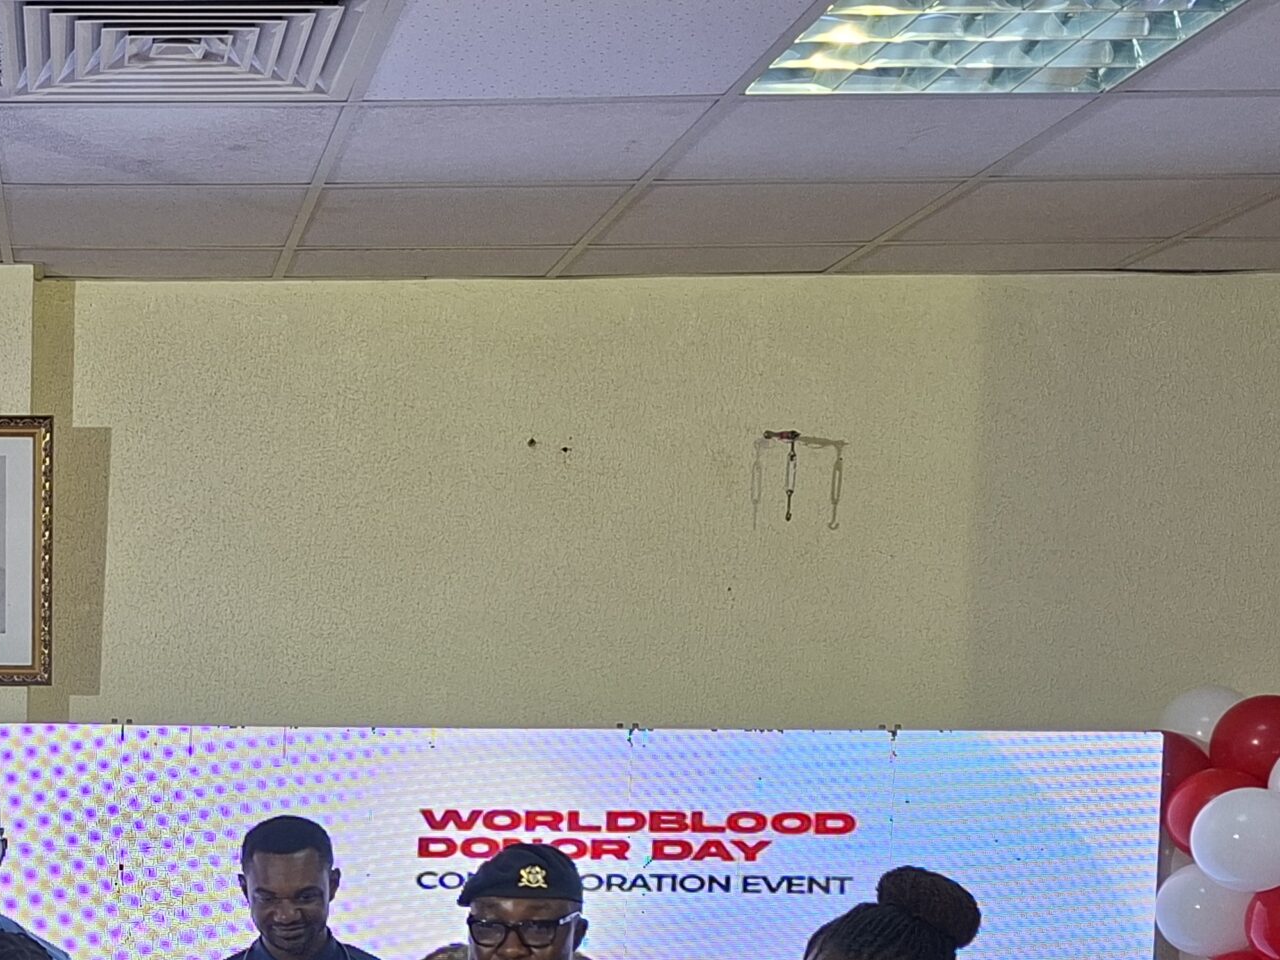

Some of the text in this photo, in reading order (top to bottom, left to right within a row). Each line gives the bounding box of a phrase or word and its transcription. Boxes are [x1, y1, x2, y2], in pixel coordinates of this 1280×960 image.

[420, 809, 857, 835] WORLDBLOOD
[417, 837, 773, 861] DOOR DAY
[741, 875, 853, 895] EVENT
